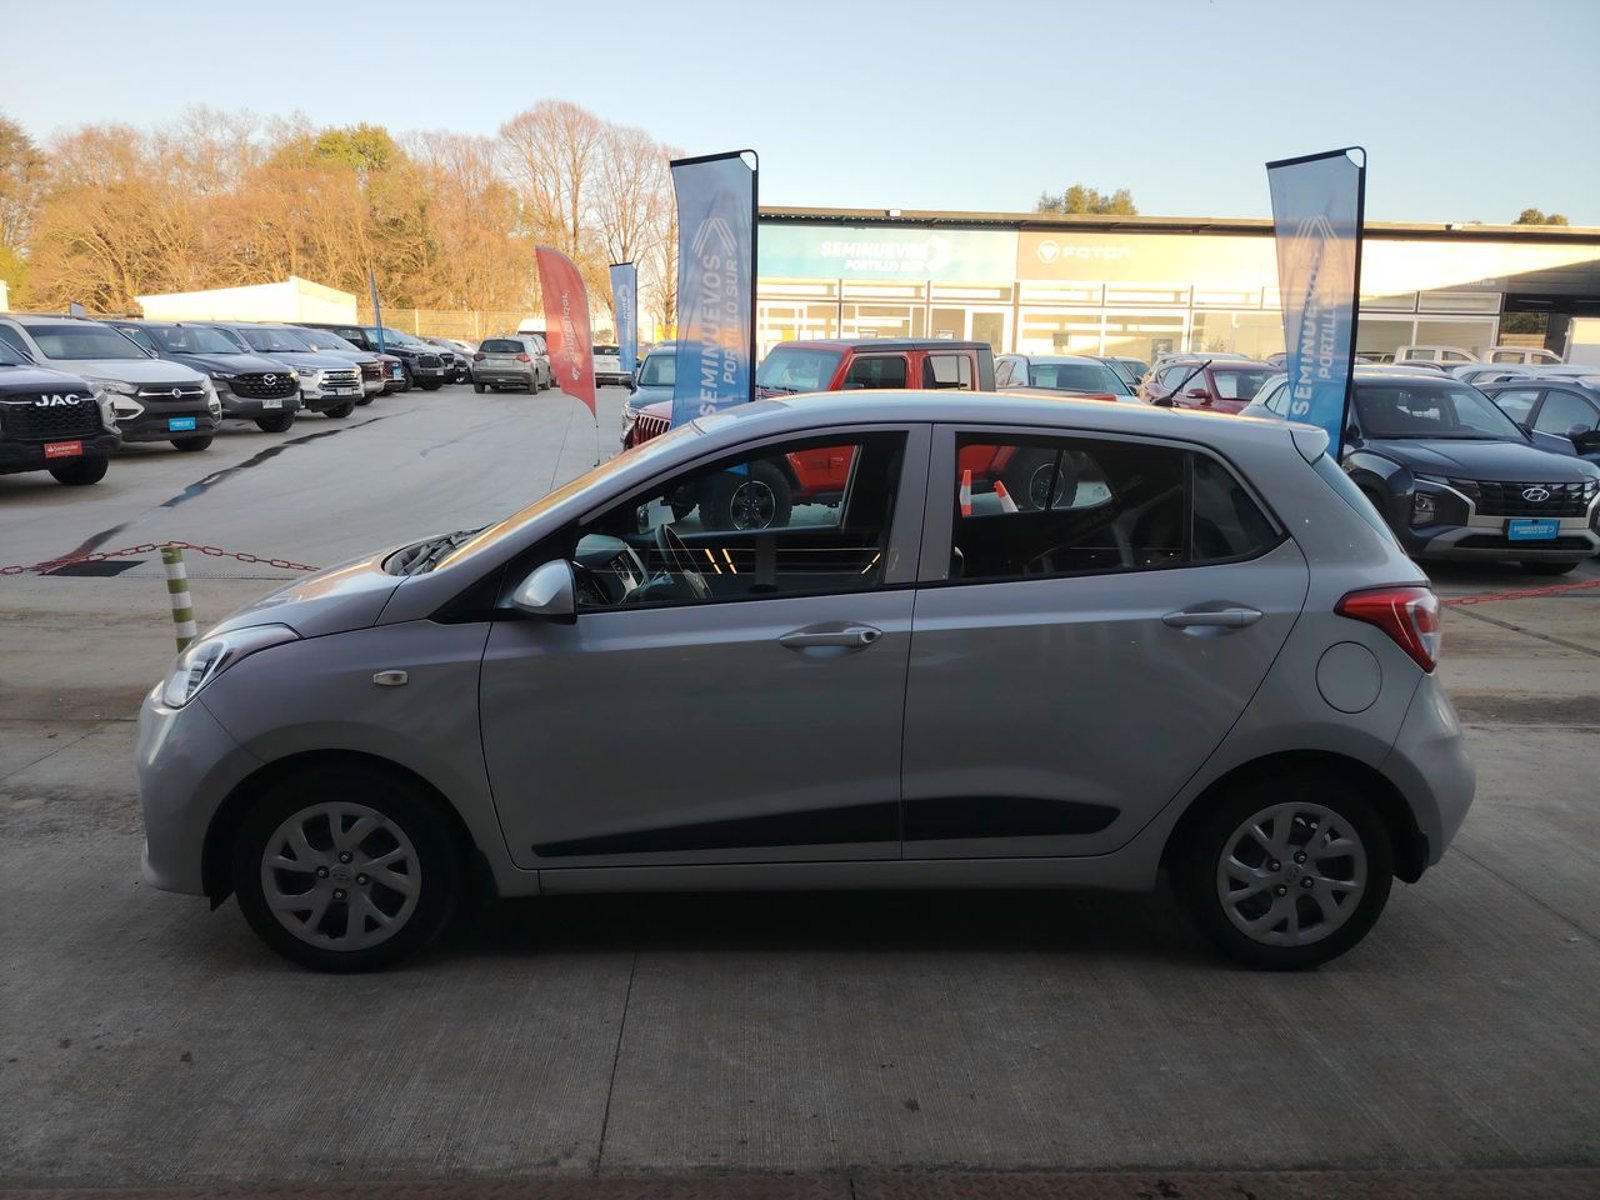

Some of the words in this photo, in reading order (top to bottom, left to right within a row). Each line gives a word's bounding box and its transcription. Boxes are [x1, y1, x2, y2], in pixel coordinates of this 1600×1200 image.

[726, 259, 738, 297] SUR
[820, 241, 928, 259] SEMINUEV
[700, 254, 721, 417] SEMINUEVOS
[723, 302, 738, 384] PORTILLO
[1292, 254, 1319, 415] SEMINUEVO
[35, 394, 81, 407] JAC
